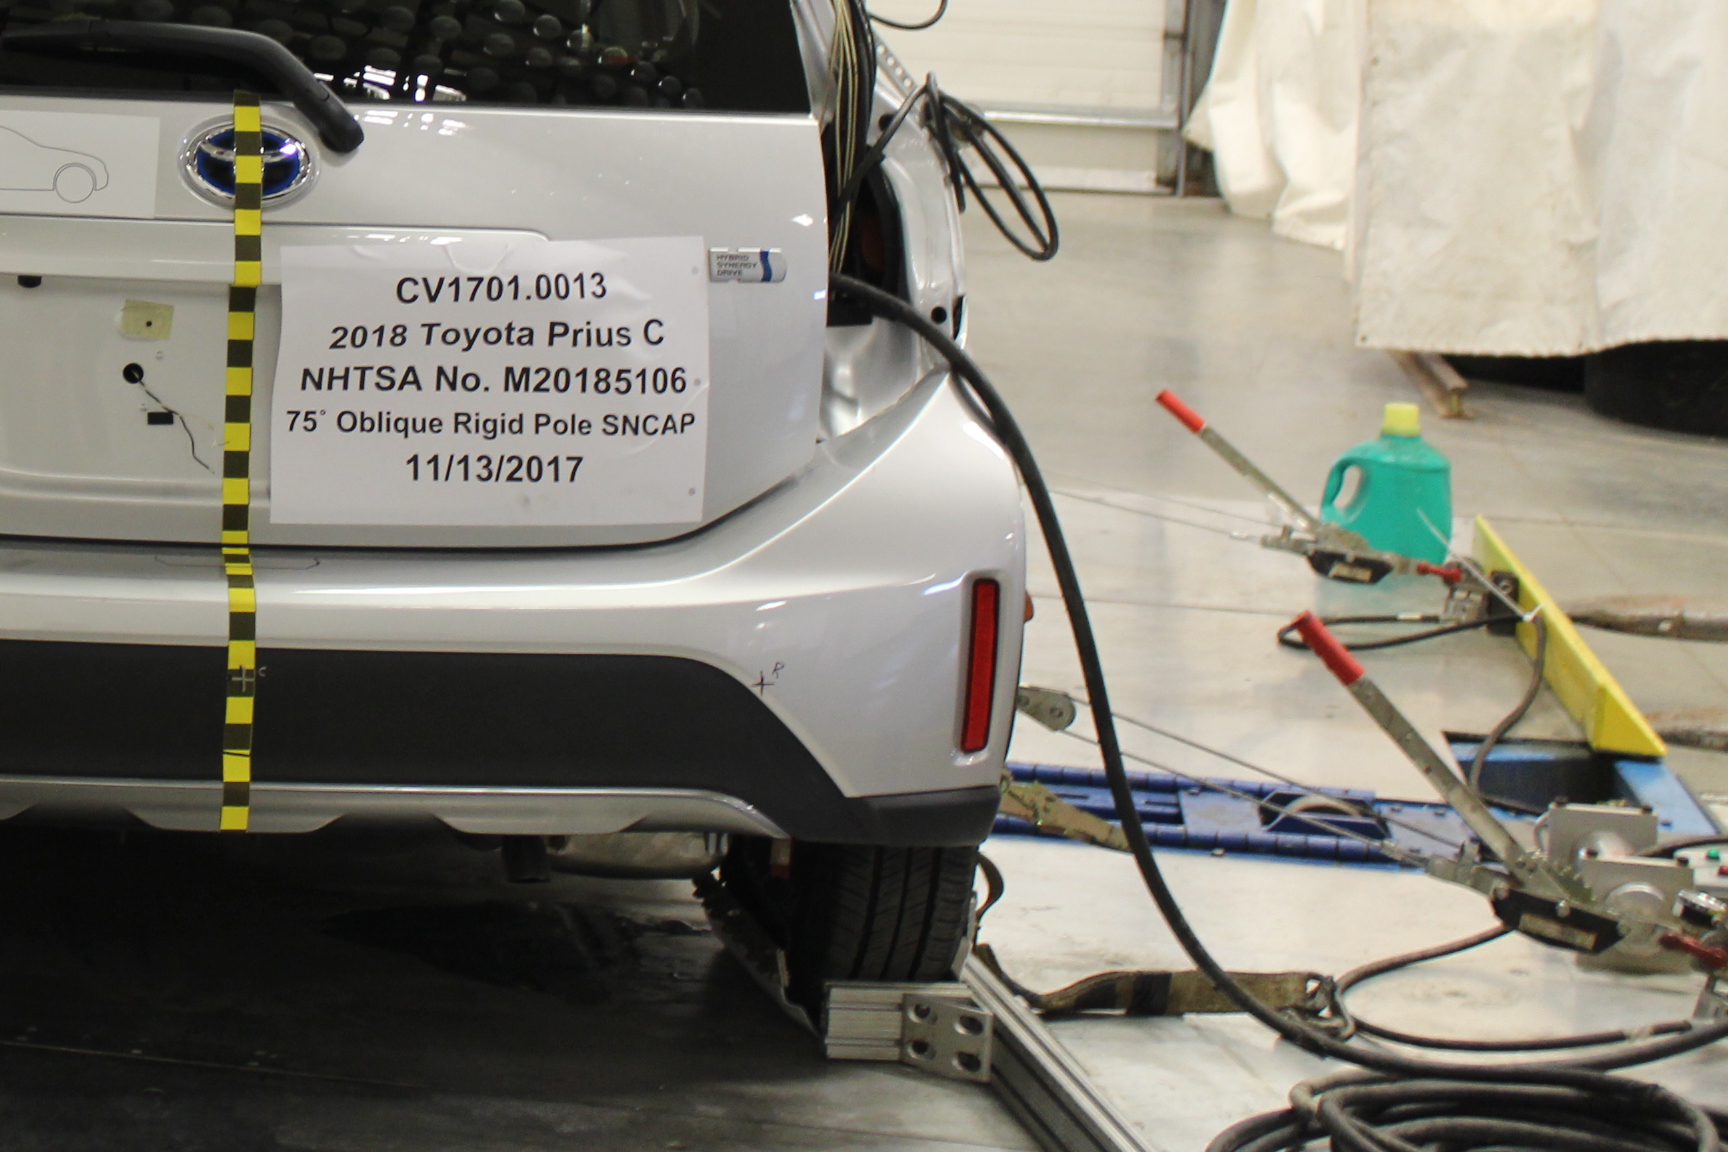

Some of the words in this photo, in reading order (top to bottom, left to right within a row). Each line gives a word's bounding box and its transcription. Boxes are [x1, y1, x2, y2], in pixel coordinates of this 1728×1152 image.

[396, 272, 607, 303] CV1701.0013
[716, 269, 743, 277] DRIVE
[329, 325, 408, 350] 2018
[421, 322, 535, 352] Toyota
[547, 321, 632, 347] Prius
[643, 318, 664, 346] C
[300, 365, 422, 392] NHTSA
[435, 366, 490, 393] No.
[503, 366, 687, 395] M20185106
[336, 410, 443, 439] Oblique
[453, 412, 524, 440] Rigid
[534, 413, 592, 436] Pole
[602, 412, 696, 436] SNCAP
[406, 453, 584, 483] 11/13/2017
